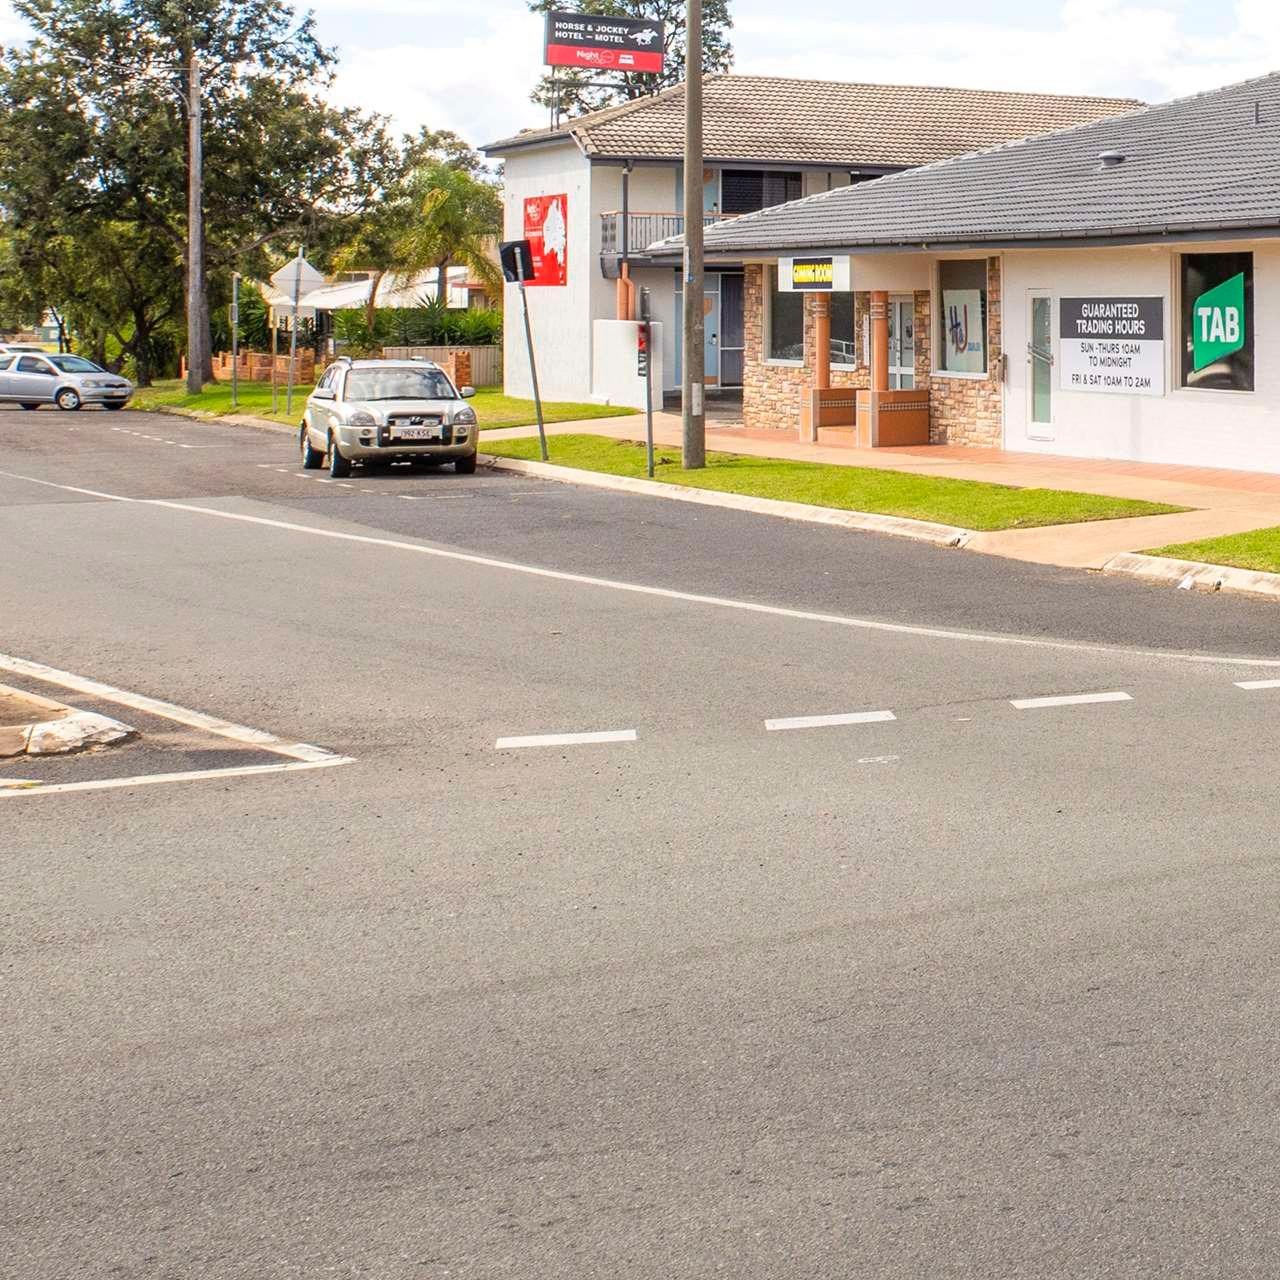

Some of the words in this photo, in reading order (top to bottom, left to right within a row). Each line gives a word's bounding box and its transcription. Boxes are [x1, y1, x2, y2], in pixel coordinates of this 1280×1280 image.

[555, 21, 585, 31] HORSE
[595, 25, 629, 35] JOCKEY
[555, 31, 584, 40] HOTEL
[595, 34, 624, 43] MOTEL
[576, 50, 599, 61] Night
[1081, 303, 1139, 318] GUARANTEED
[1076, 320, 1113, 334] TRADING
[1115, 320, 1145, 335] HOURS
[1197, 306, 1240, 343] TAB
[1081, 342, 1094, 353] SUN
[1121, 343, 1141, 355] 10AM
[1089, 355, 1098, 367] TO
[1100, 356, 1132, 368] MIDNIGHT
[1072, 373, 1081, 384] FRI
[1083, 374, 1088, 385] &
[1089, 374, 1102, 385] SAT
[1103, 375, 1122, 386] 10AM
[1124, 376, 1134, 387] TO
[1135, 376, 1151, 388] 2AM
